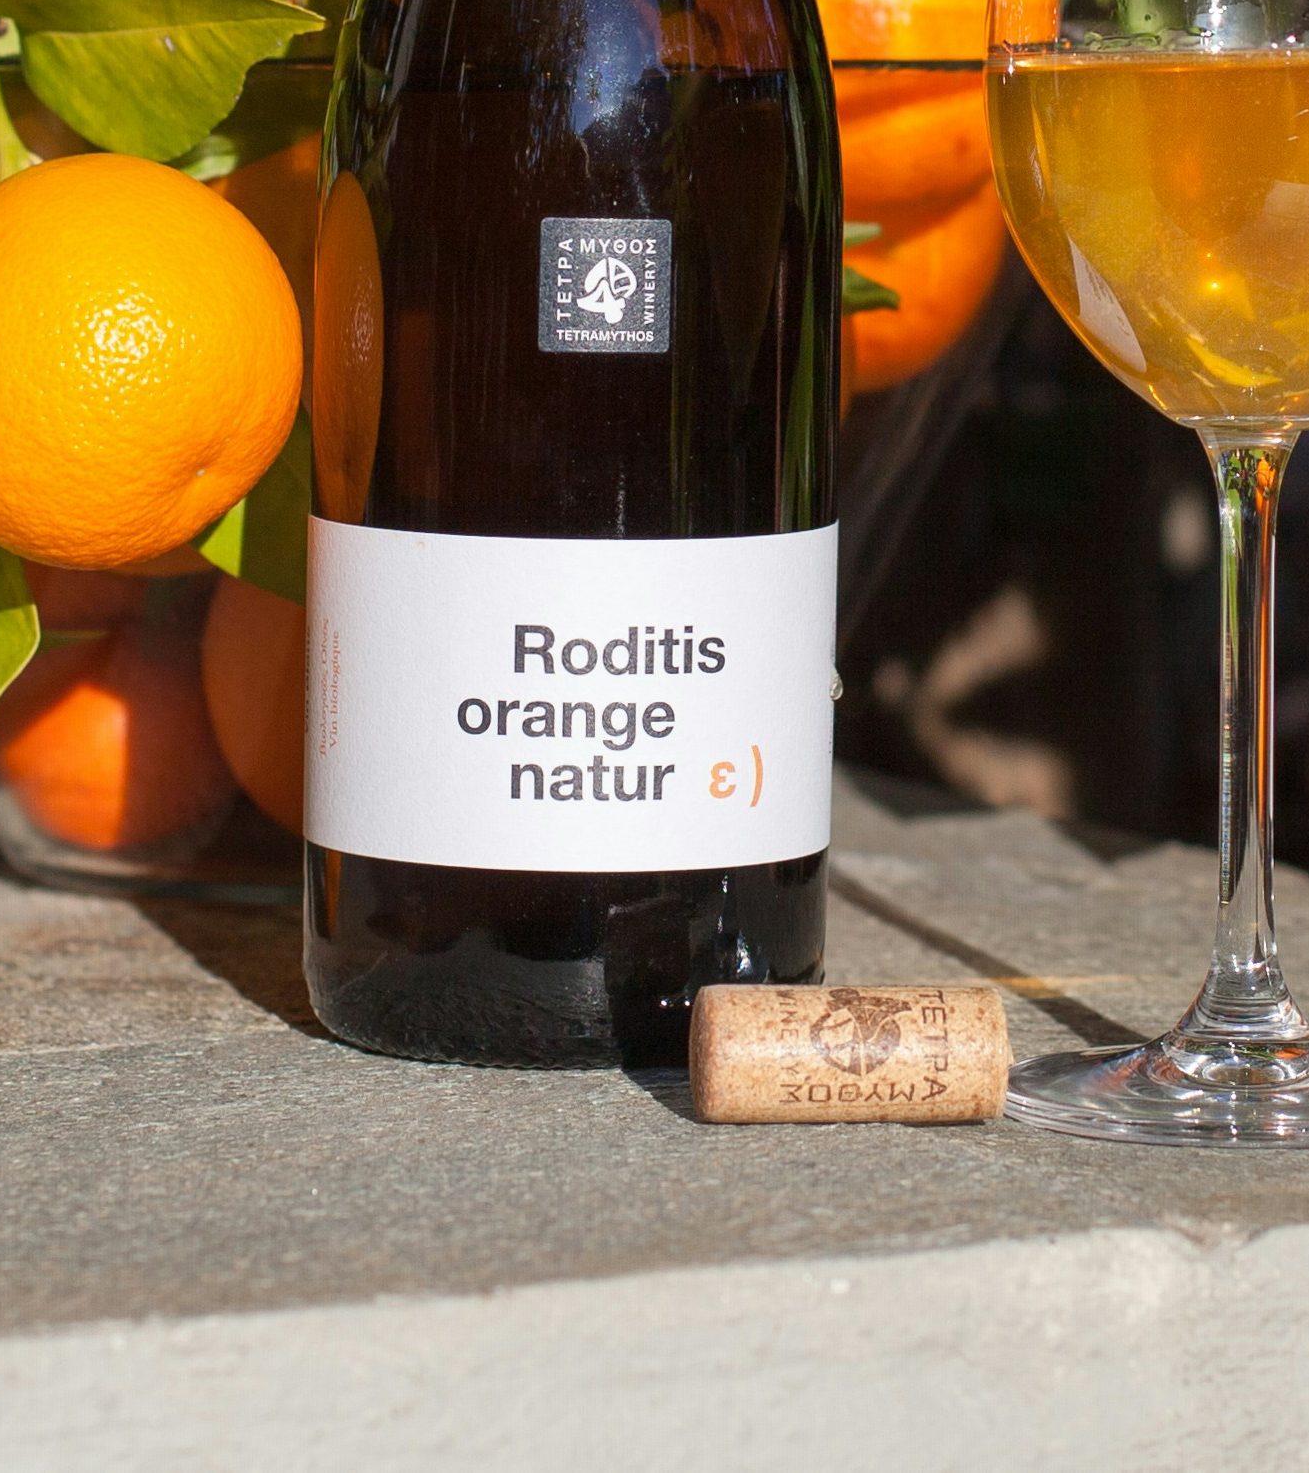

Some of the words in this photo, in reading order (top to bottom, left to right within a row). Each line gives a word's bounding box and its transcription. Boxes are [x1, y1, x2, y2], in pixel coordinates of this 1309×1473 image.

[643, 257, 656, 325] WINERY
[556, 329, 654, 342] TETRAMYTHOS
[330, 630, 340, 714] biologique
[512, 624, 726, 676] Roditis
[329, 721, 339, 748] Vin
[457, 697, 676, 751] orange
[510, 755, 675, 801] natur
[775, 989, 800, 1079] WINEY
